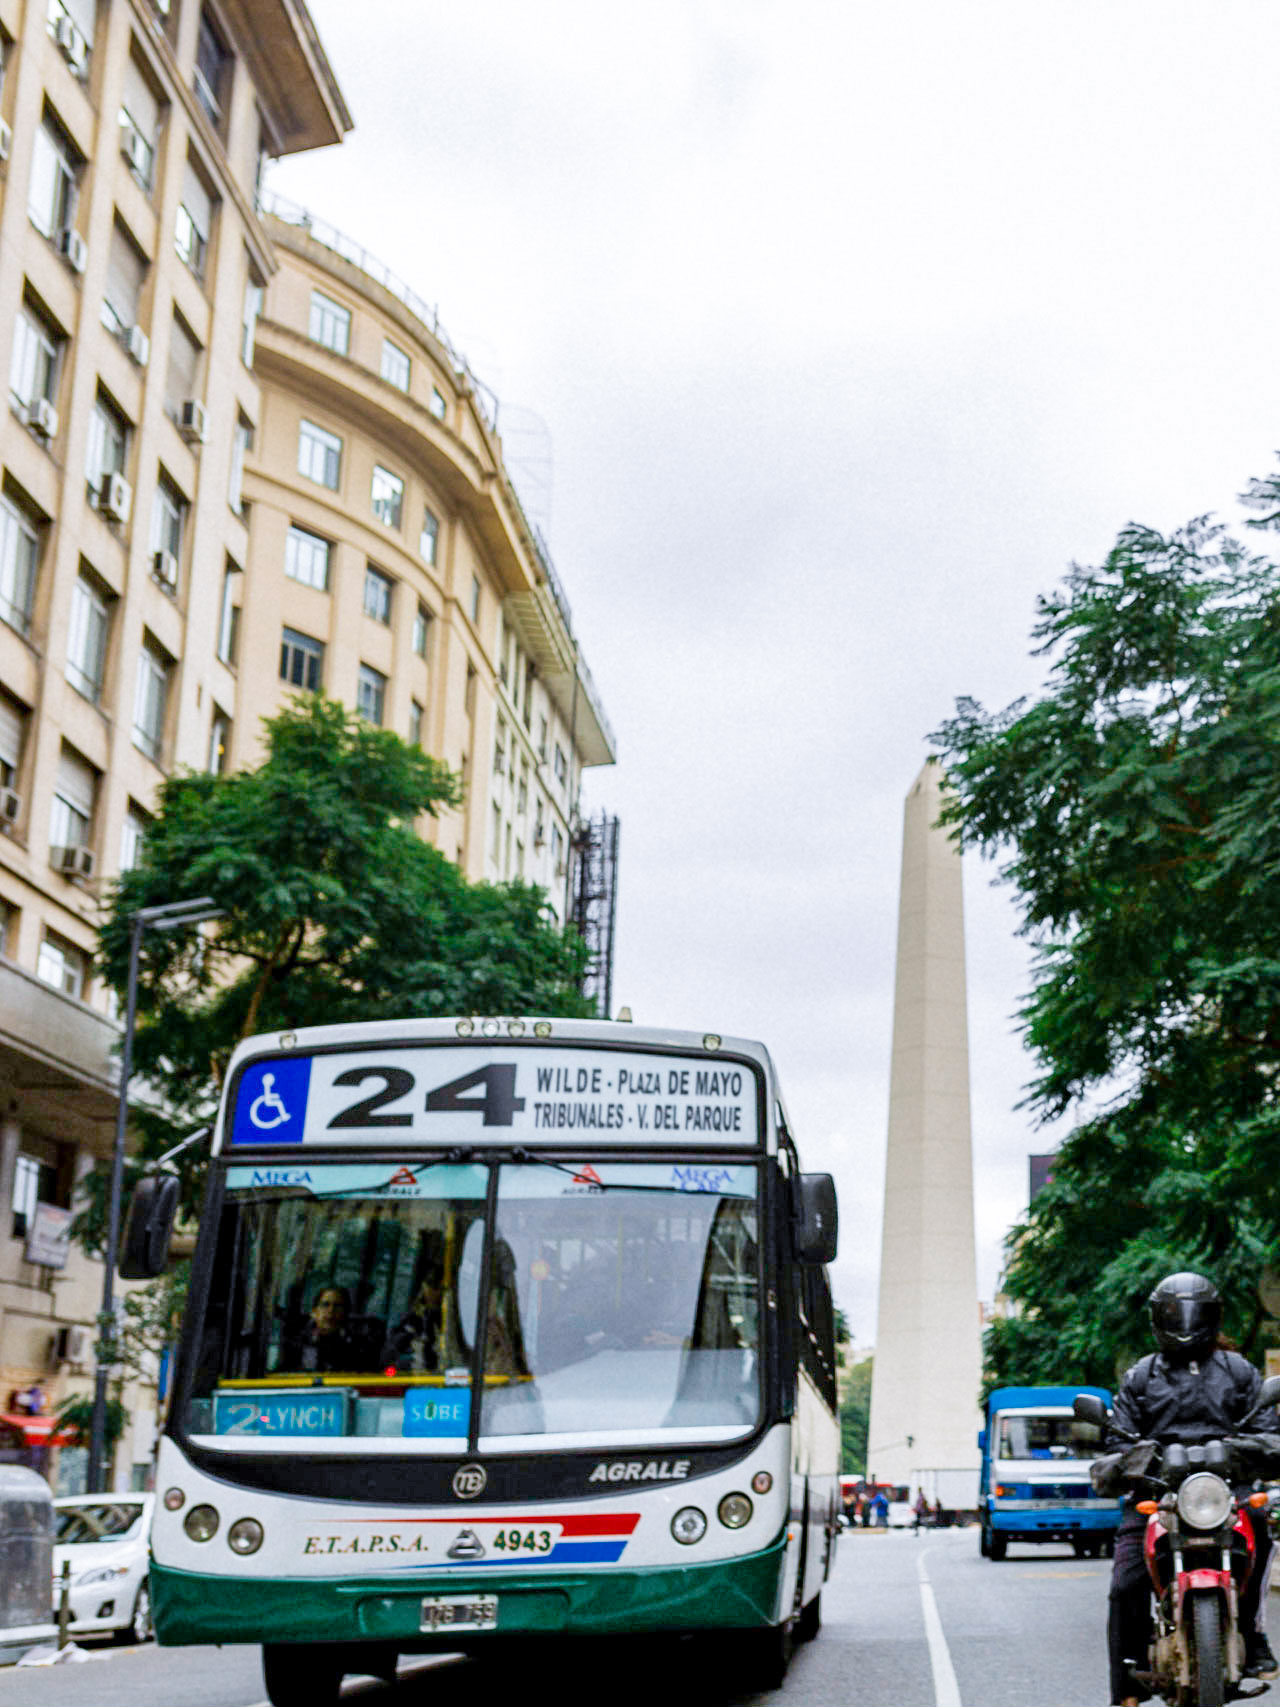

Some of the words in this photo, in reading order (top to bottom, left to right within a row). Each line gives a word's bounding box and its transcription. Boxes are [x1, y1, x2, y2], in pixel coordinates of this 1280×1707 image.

[537, 1067, 602, 1092] WILDE
[618, 1069, 661, 1095] PLAZA
[668, 1071, 690, 1096] DE
[695, 1071, 742, 1097] MAYO
[326, 1063, 526, 1129] 24
[534, 1103, 624, 1129] TRIBUNALES
[637, 1104, 648, 1129] V.
[654, 1104, 680, 1130] DEL
[685, 1105, 741, 1132] PARQUE
[265, 1407, 335, 1431] LYNCH
[588, 1460, 691, 1483] AGRALE
[303, 1534, 429, 1554] E.T.A.P.S.A.
[493, 1529, 552, 1552] 4943
